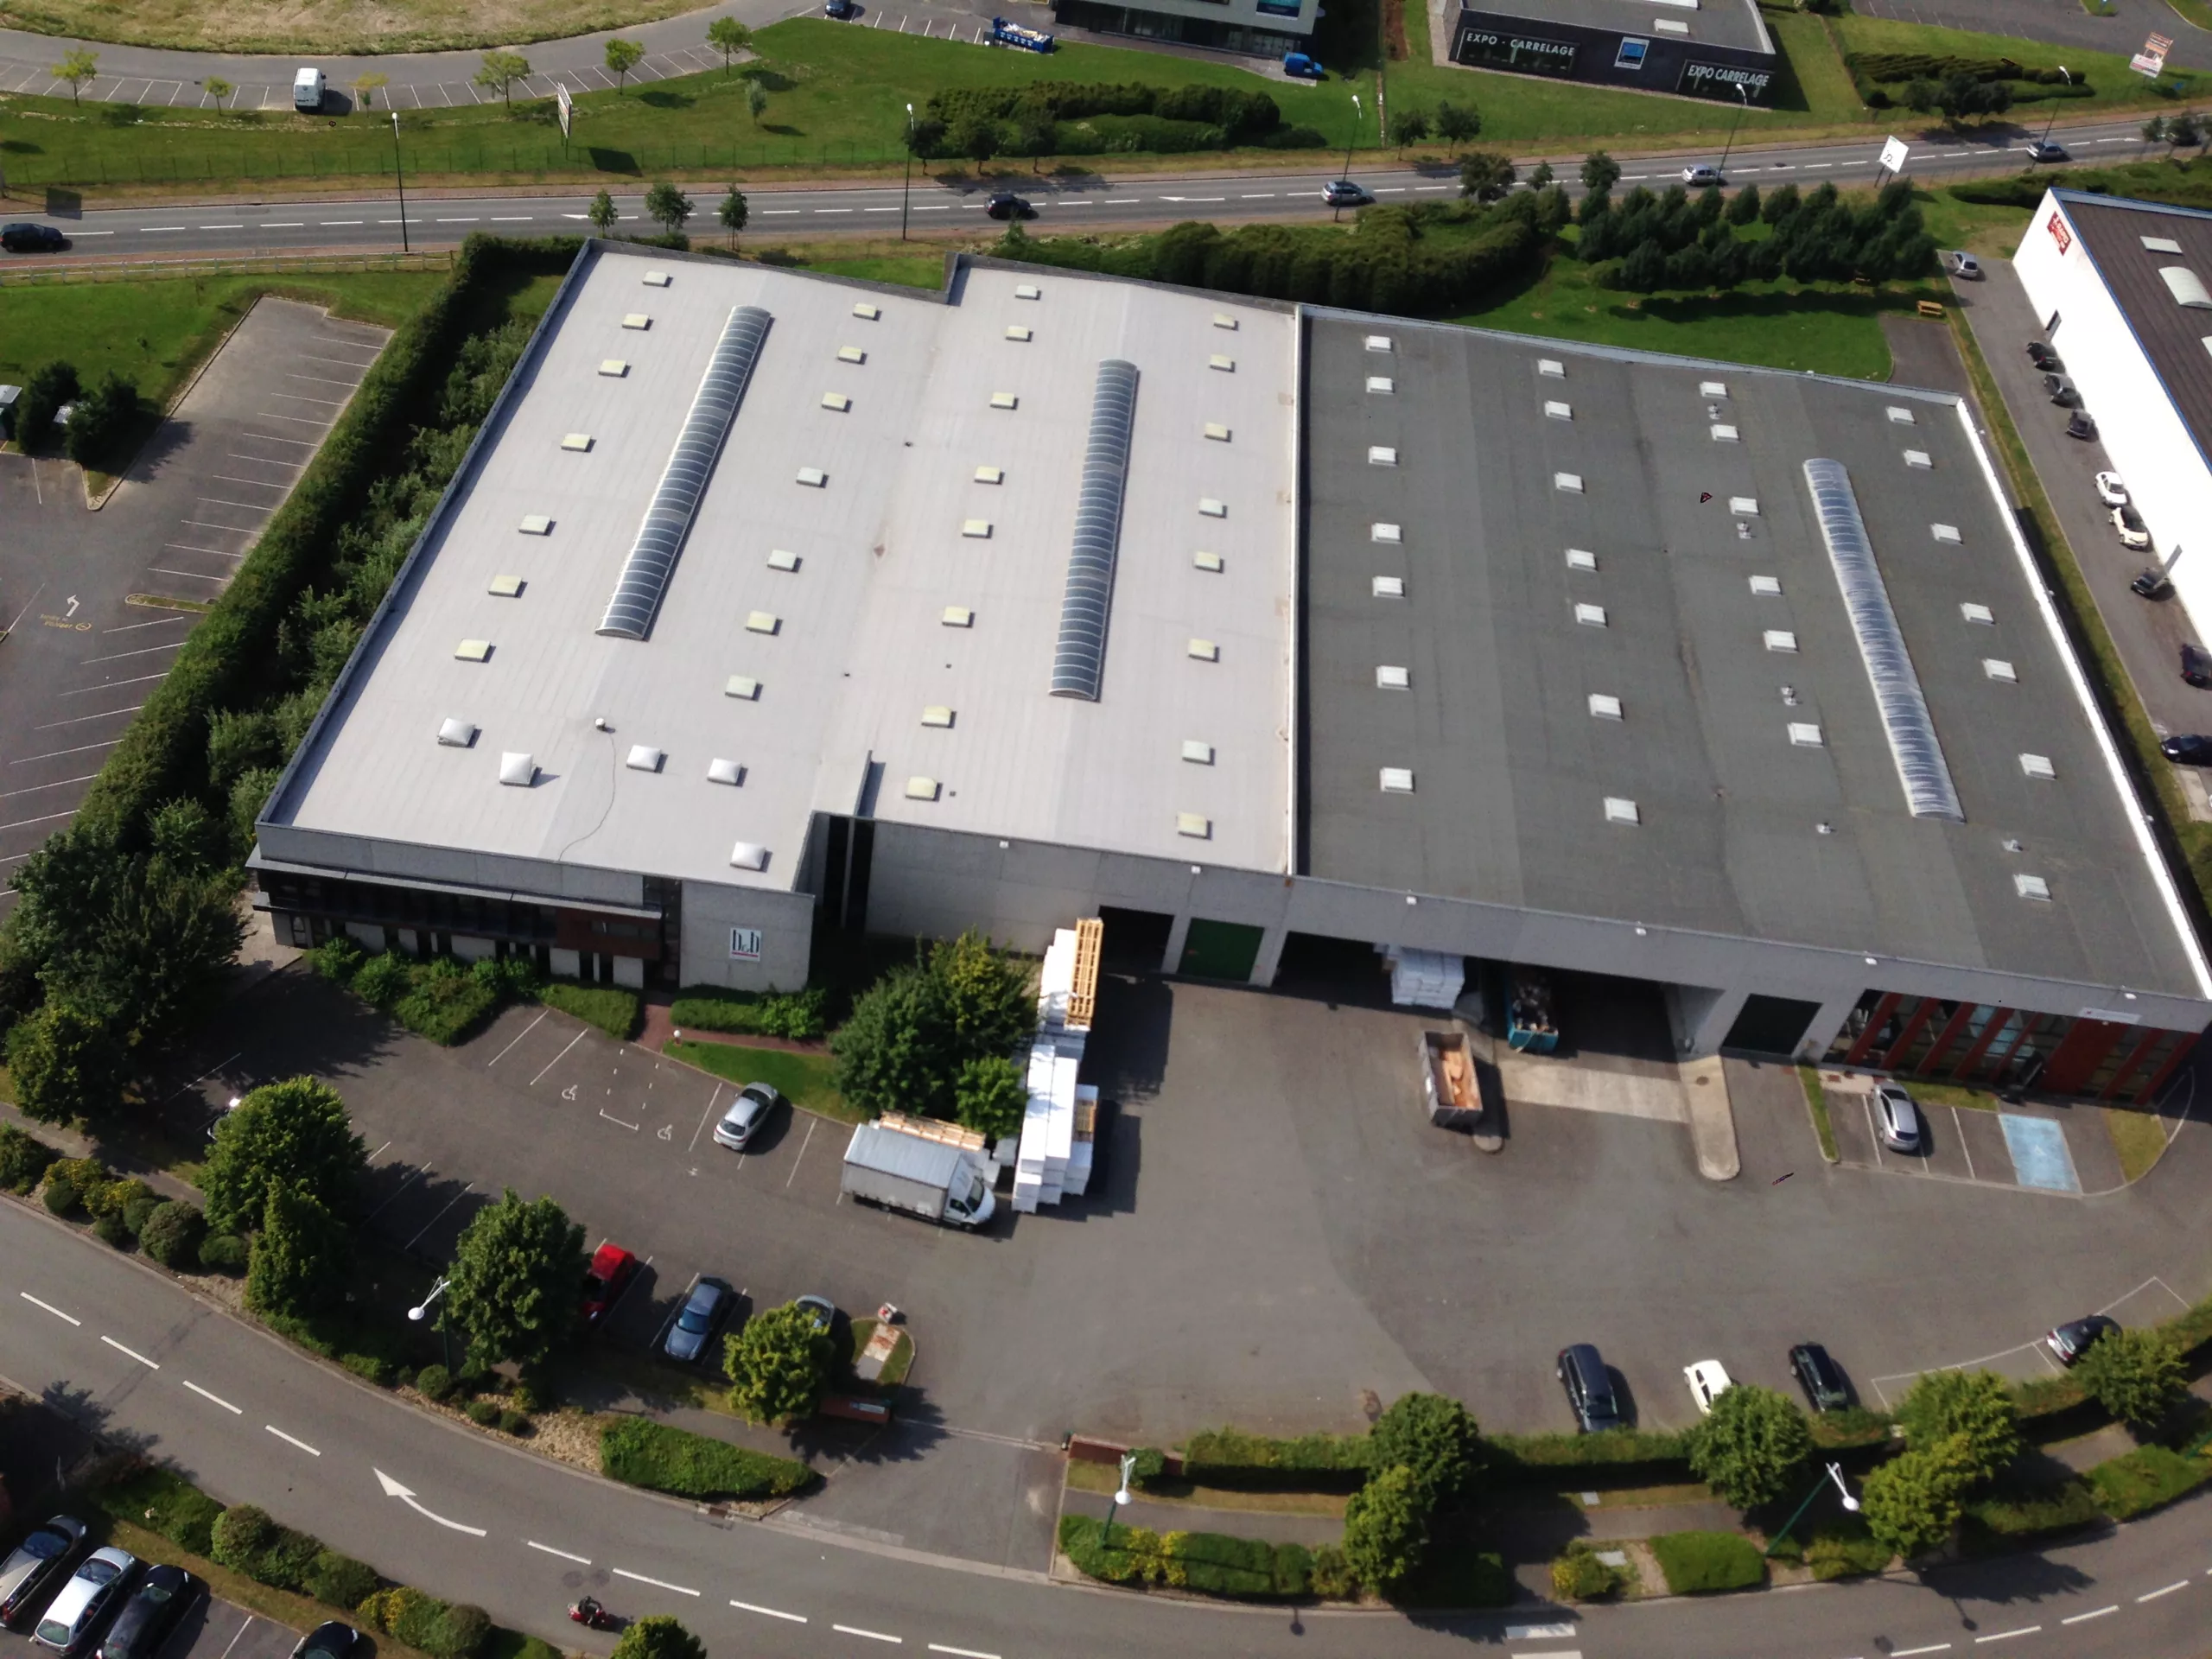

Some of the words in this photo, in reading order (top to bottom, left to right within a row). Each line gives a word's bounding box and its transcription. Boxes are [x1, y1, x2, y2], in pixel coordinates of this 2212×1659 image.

[1466, 33, 1497, 45] EXPO
[1510, 39, 1575, 56] CARRELAGE
[1688, 65, 1714, 79] EXPO
[1715, 69, 1770, 86] CARRELAGE
